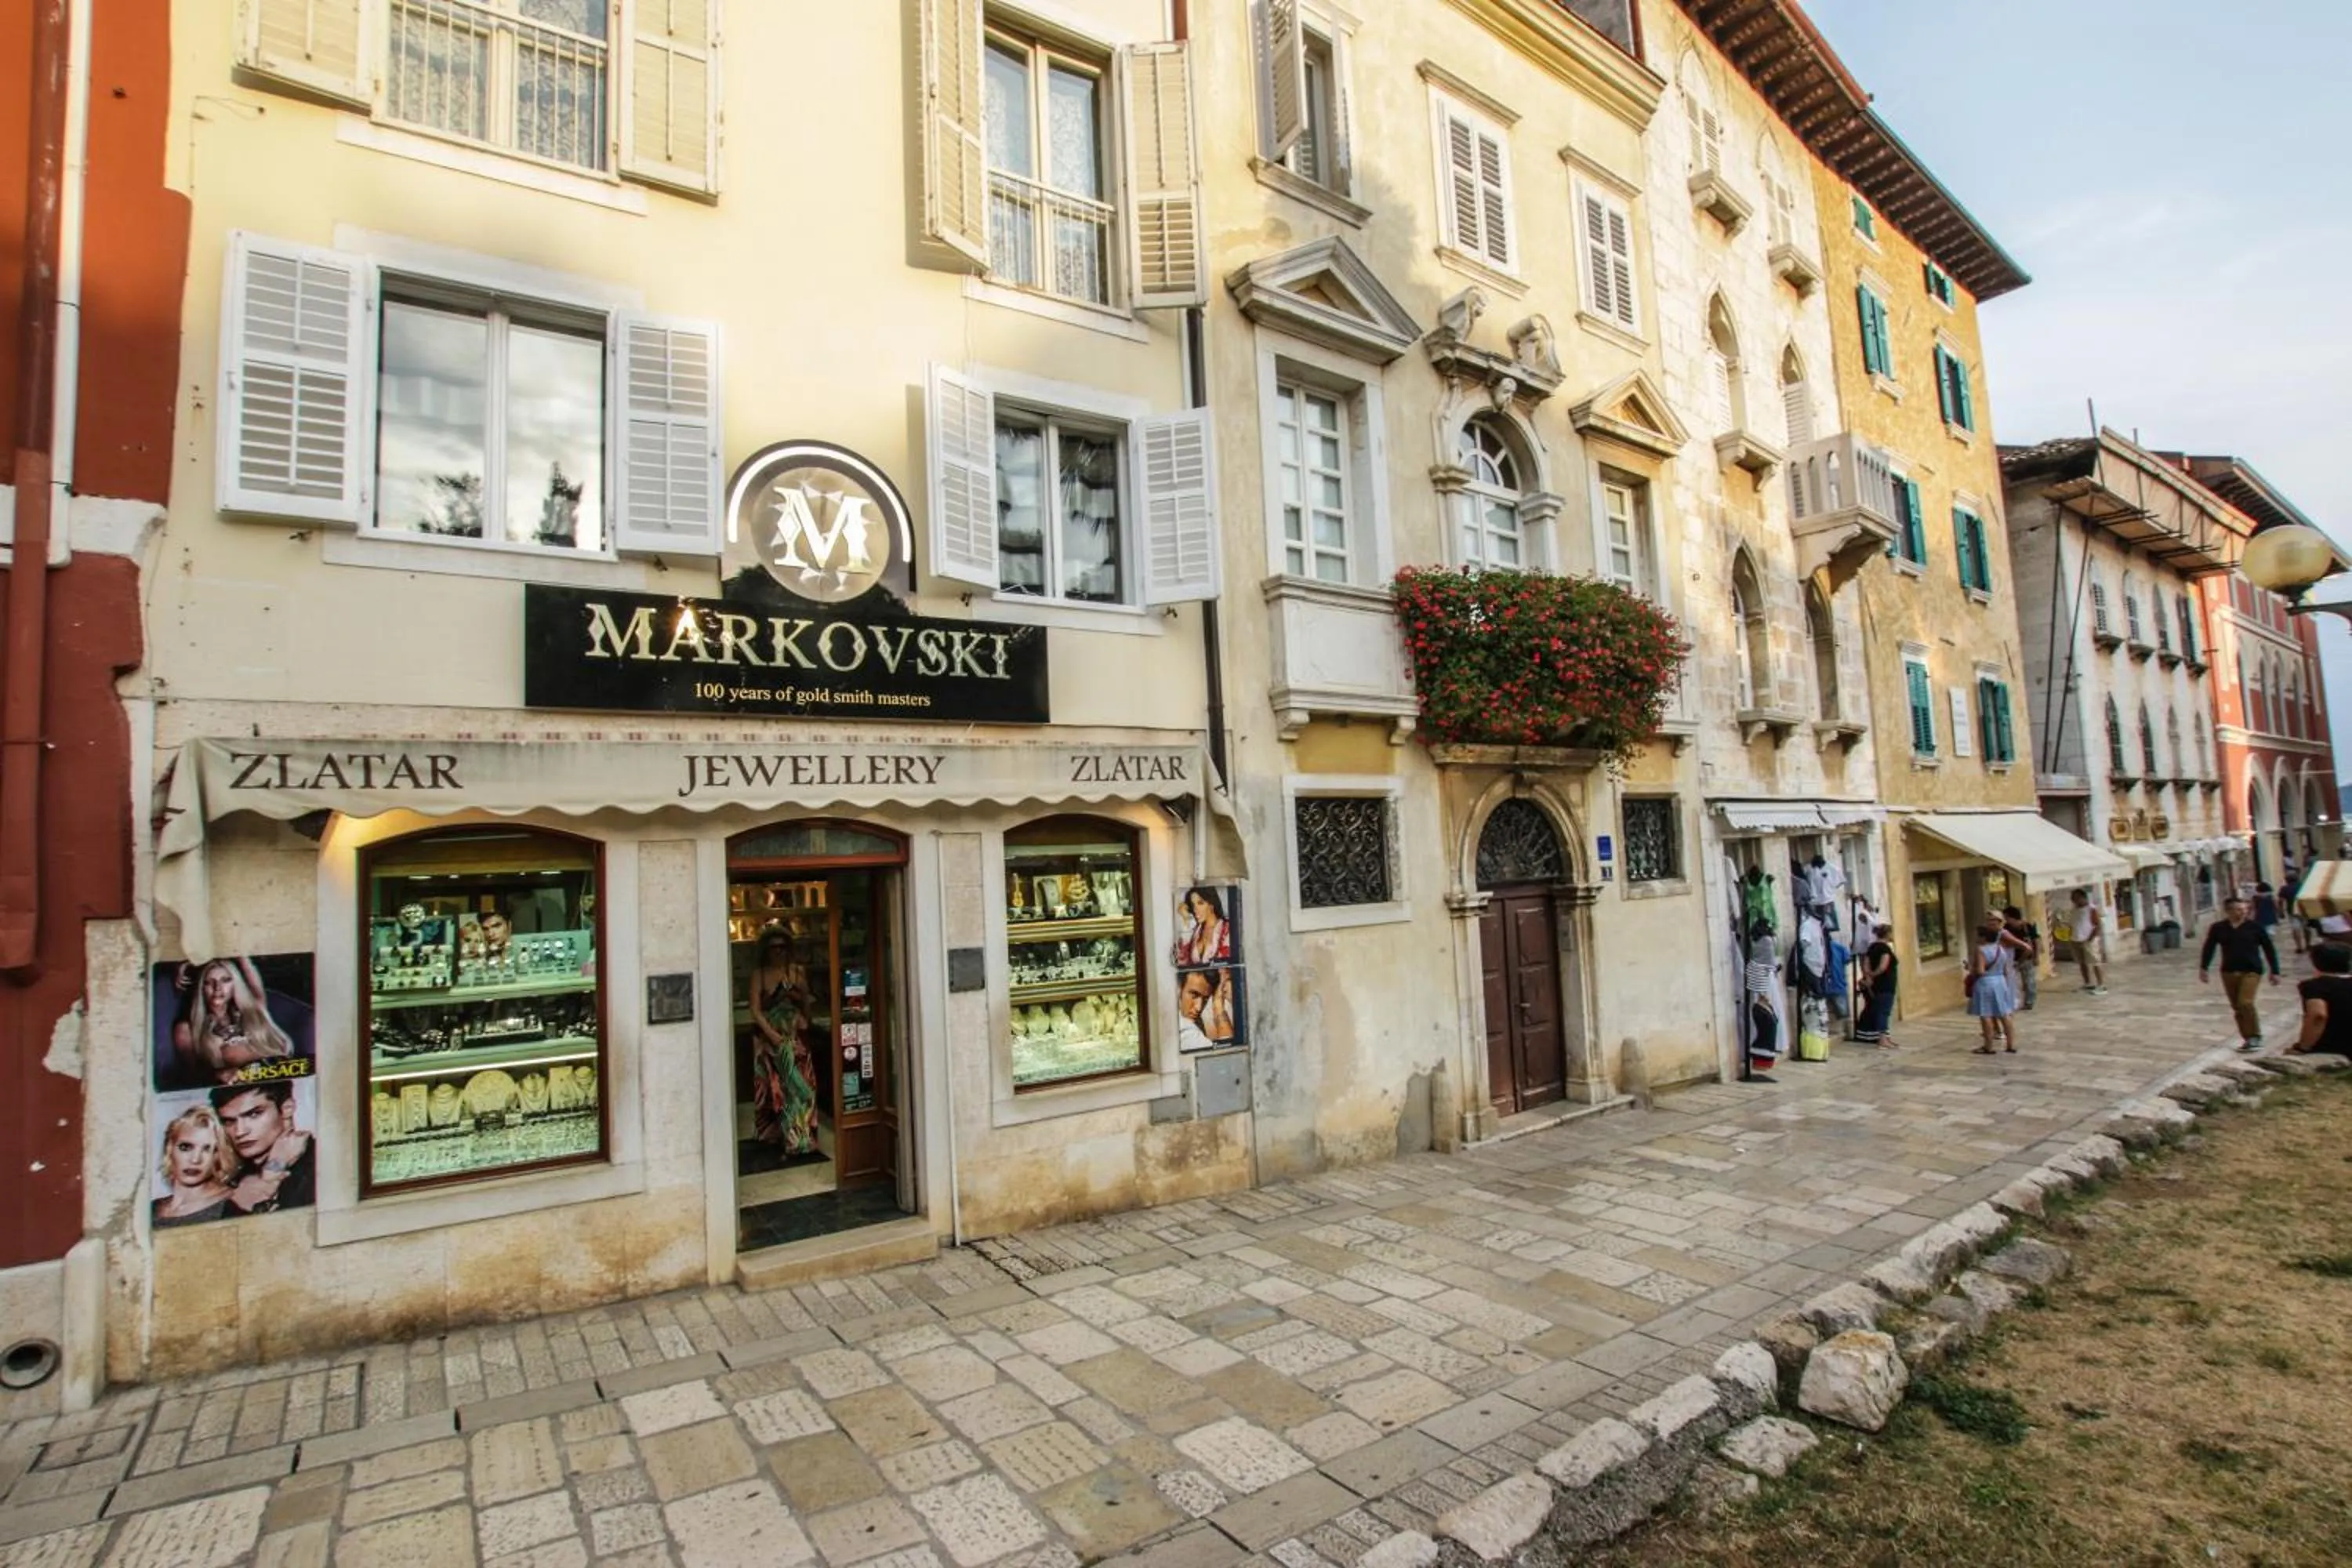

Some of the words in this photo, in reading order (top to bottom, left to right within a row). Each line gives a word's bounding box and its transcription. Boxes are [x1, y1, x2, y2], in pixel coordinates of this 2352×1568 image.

[772, 485, 871, 574] M
[584, 602, 1012, 680] MARKOVSKI
[694, 682, 724, 699] 100
[728, 687, 771, 702] years
[775, 685, 794, 701] of
[796, 688, 829, 705] gold
[833, 689, 874, 704] smith
[877, 693, 931, 706] masters
[229, 753, 464, 790] ZLATAR
[677, 753, 946, 797] JEWELLERY
[1070, 755, 1187, 782] ZLATAR
